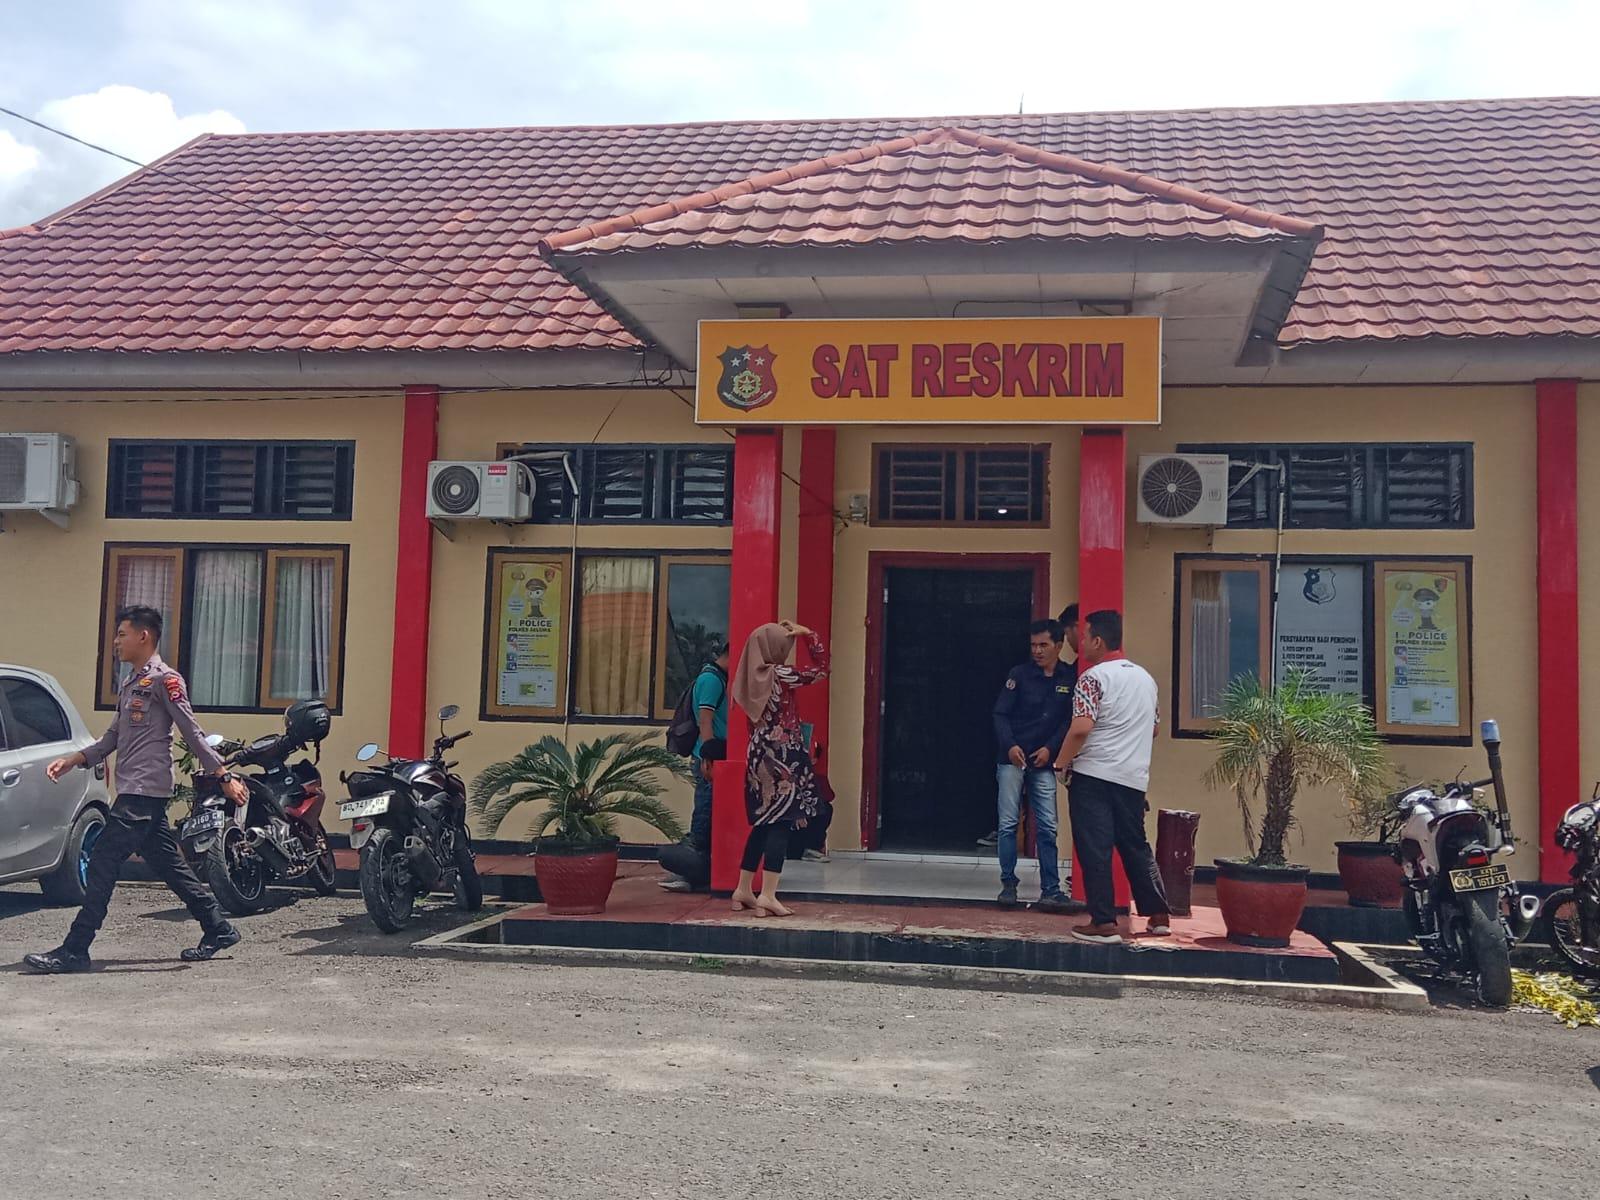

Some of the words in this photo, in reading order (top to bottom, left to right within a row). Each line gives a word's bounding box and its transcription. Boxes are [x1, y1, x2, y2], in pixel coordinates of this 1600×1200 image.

[811, 343, 899, 399] SAT
[911, 342, 1125, 399] RESKRIM
[1408, 632, 1449, 640] POLICE
